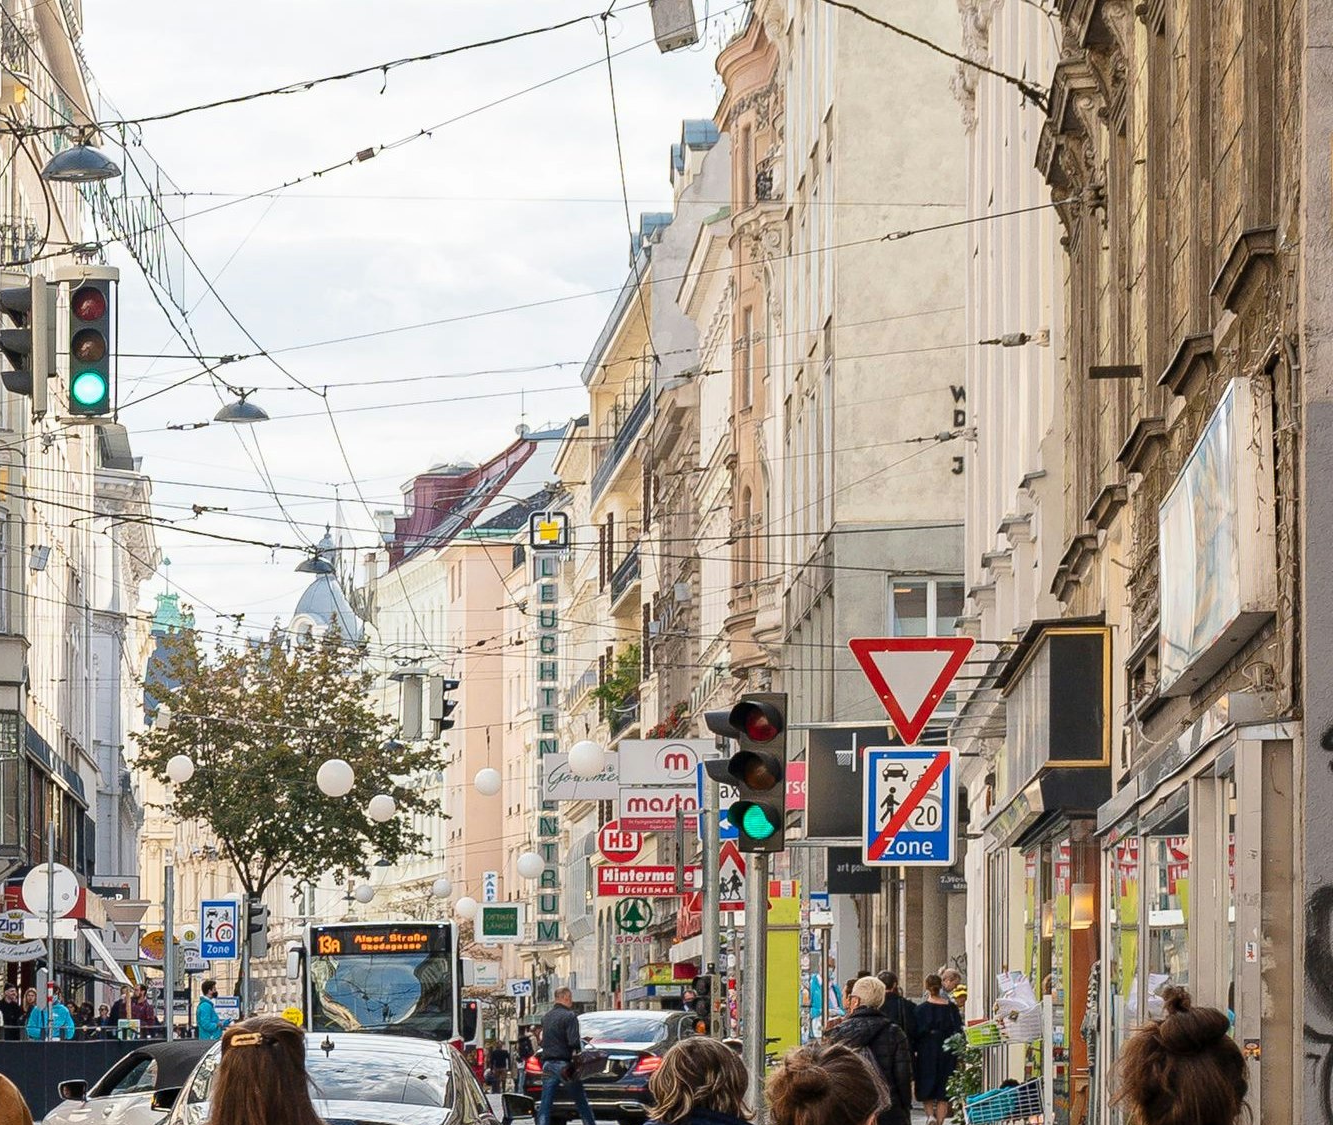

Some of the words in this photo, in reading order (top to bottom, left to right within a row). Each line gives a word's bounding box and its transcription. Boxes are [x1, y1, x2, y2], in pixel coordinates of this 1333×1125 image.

[914, 805, 938, 826] 20
[608, 832, 633, 848] HB
[884, 837, 933, 856] Zone
[221, 929, 232, 940] 20
[615, 935, 652, 944] SPAR
[206, 944, 230, 954] Zone
[318, 934, 341, 953] 13A
